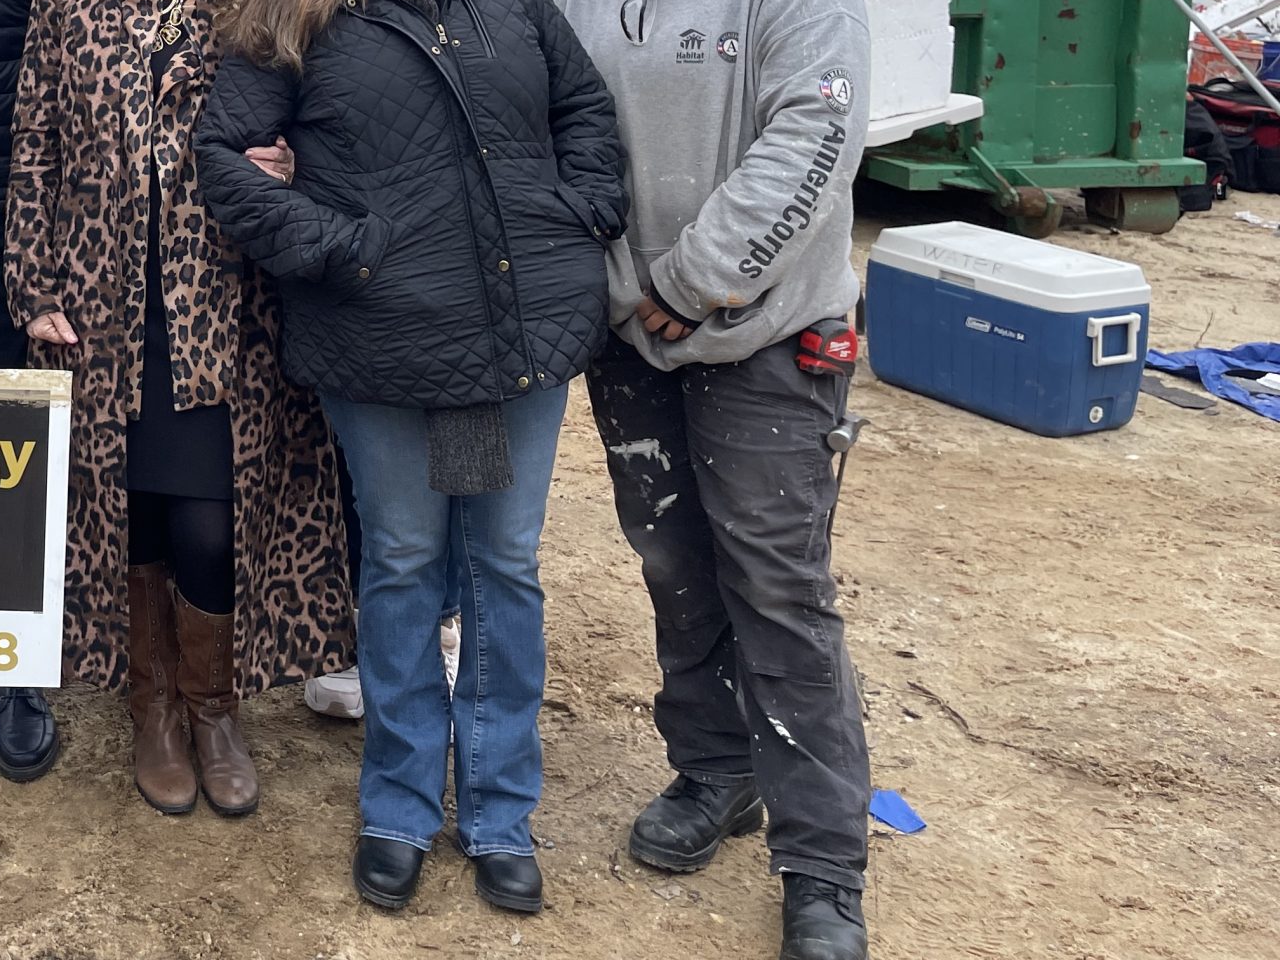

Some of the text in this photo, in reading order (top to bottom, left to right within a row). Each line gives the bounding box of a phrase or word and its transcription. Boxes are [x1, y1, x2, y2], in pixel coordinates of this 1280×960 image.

[676, 51, 704, 59] Habitat
[738, 120, 847, 280] AmeriCorps
[923, 244, 1004, 275] WATER
